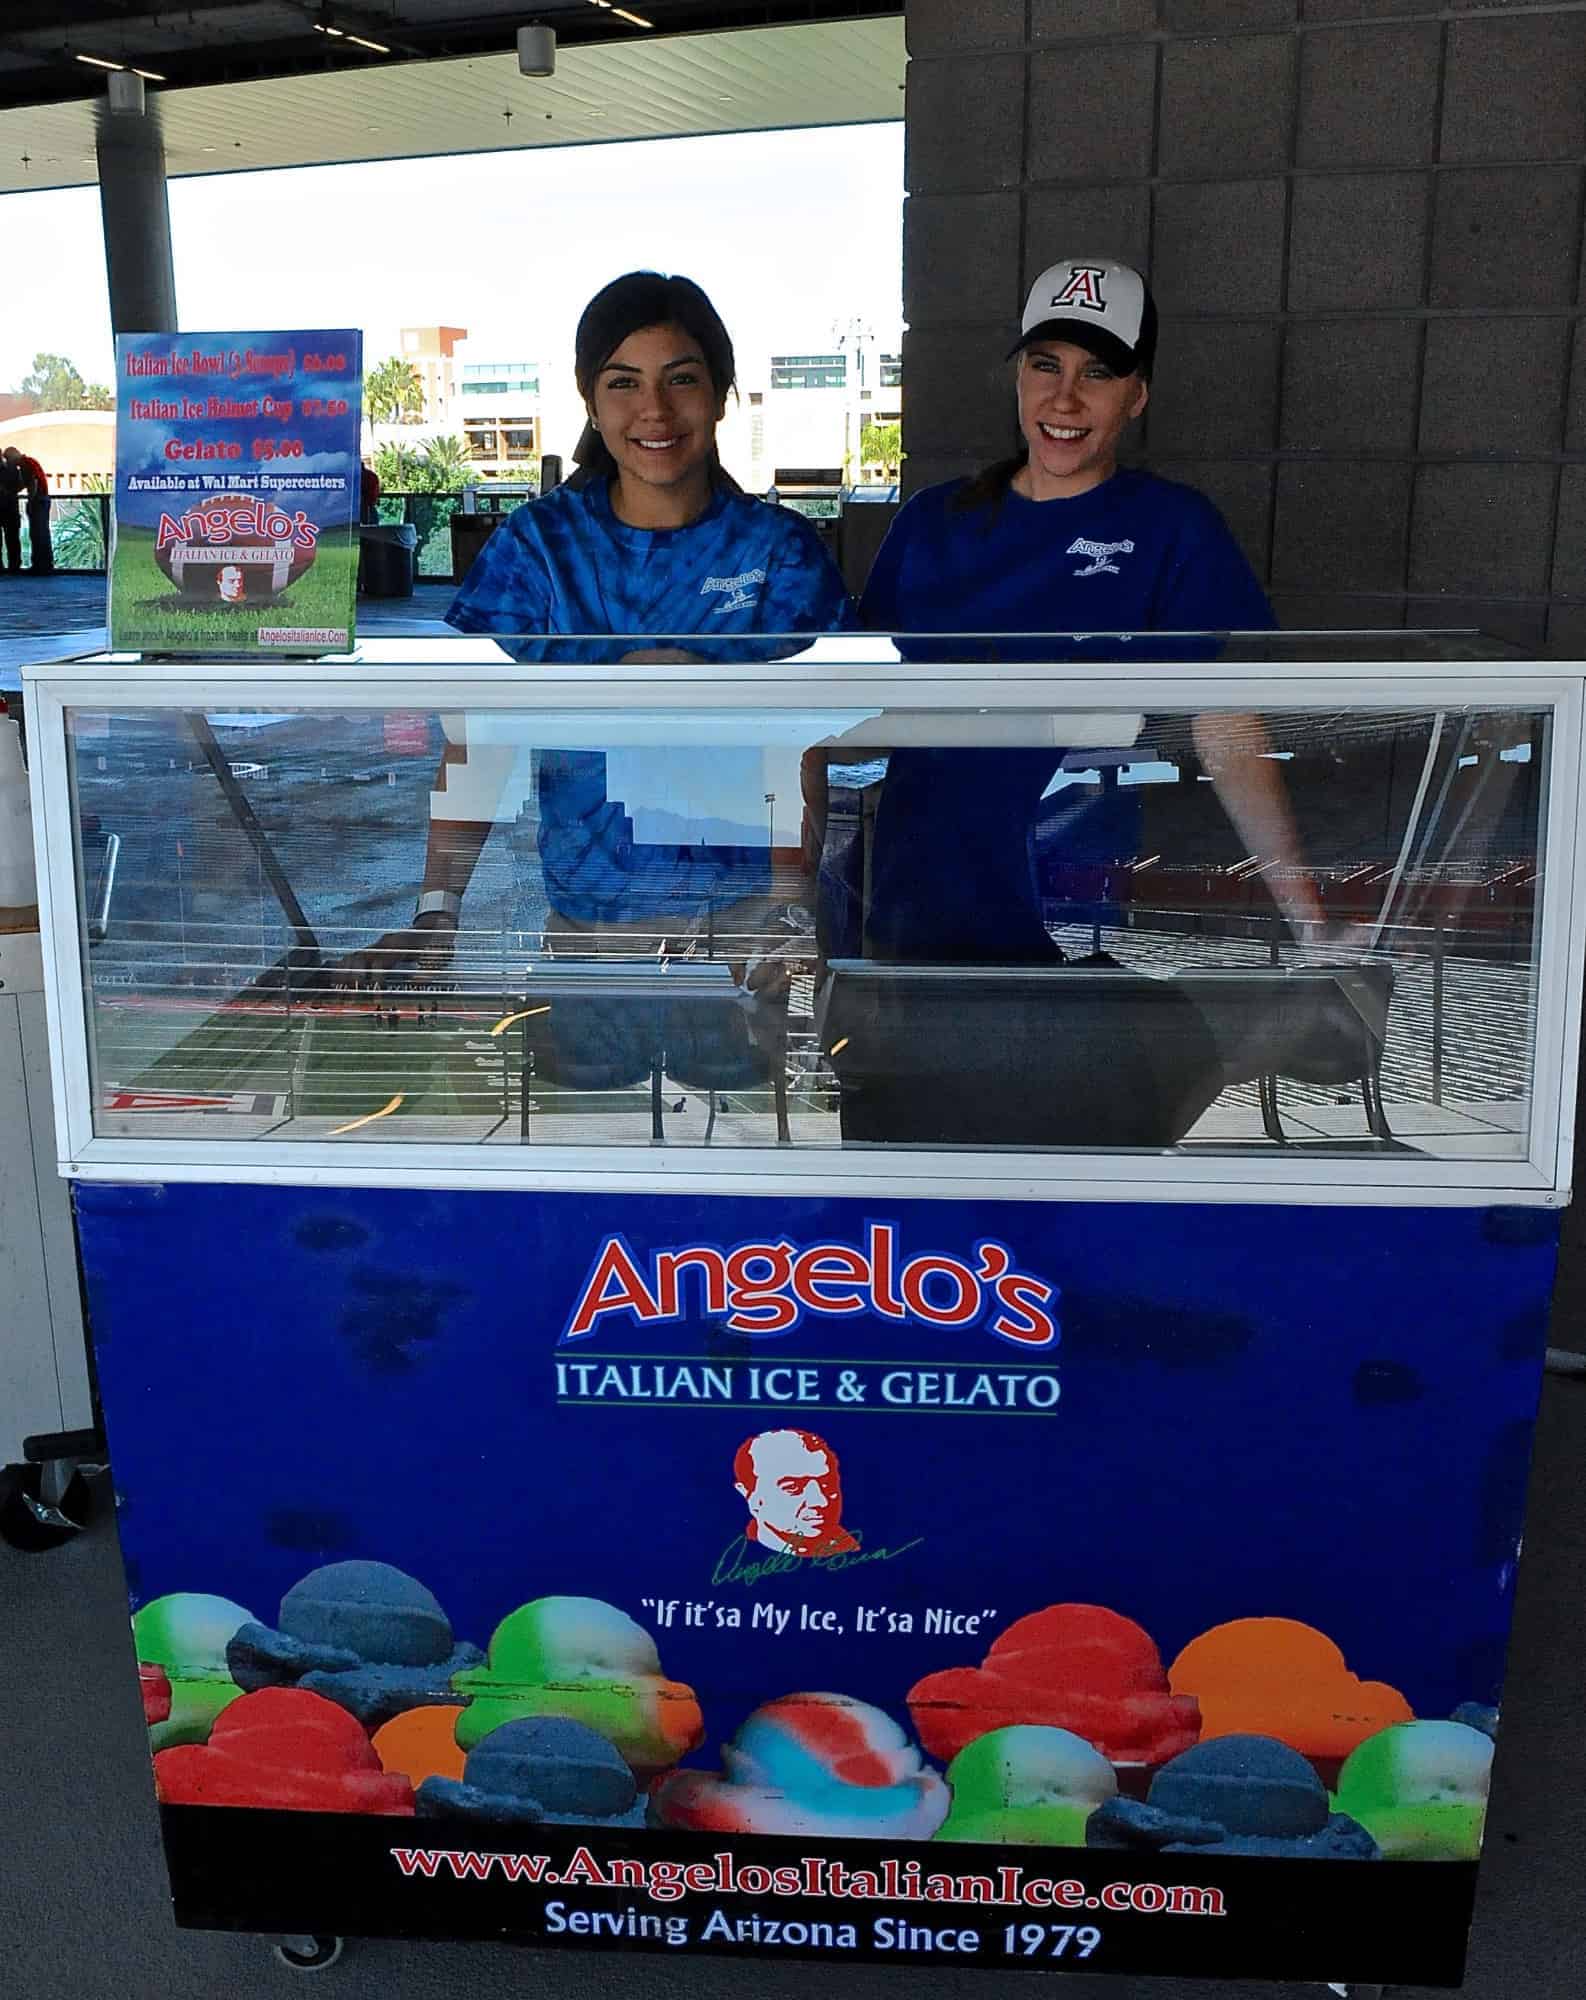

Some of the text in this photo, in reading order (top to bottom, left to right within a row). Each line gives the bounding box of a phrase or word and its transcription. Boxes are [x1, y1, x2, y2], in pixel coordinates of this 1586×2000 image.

[1051, 267, 1107, 313] A
[126, 351, 168, 376] Italian
[172, 351, 189, 375] Ice
[192, 351, 225, 375] Bowl
[131, 398, 178, 420] Italian
[182, 397, 203, 419] Ice
[207, 396, 258, 418] Helmet
[262, 394, 293, 423] Cup
[164, 438, 242, 460] Gelato
[128, 475, 345, 491] Available at Wal Mart Supercenters
[157, 502, 320, 549] Angelo's
[174, 548, 294, 561] ITALIAN ICE & GELATO
[566, 1224, 1054, 1345] Angelo's
[556, 1363, 1061, 1408] ITALIAN ICE & GELATO
[685, 1600, 741, 1628] it'sa
[751, 1602, 791, 1635] My
[800, 1603, 844, 1635] Ice,
[856, 1605, 913, 1633] It'sa
[390, 1846, 1228, 1916] www.AngelosItalianIce.com
[544, 1901, 1102, 1958] Serving Arizona Since 1979
